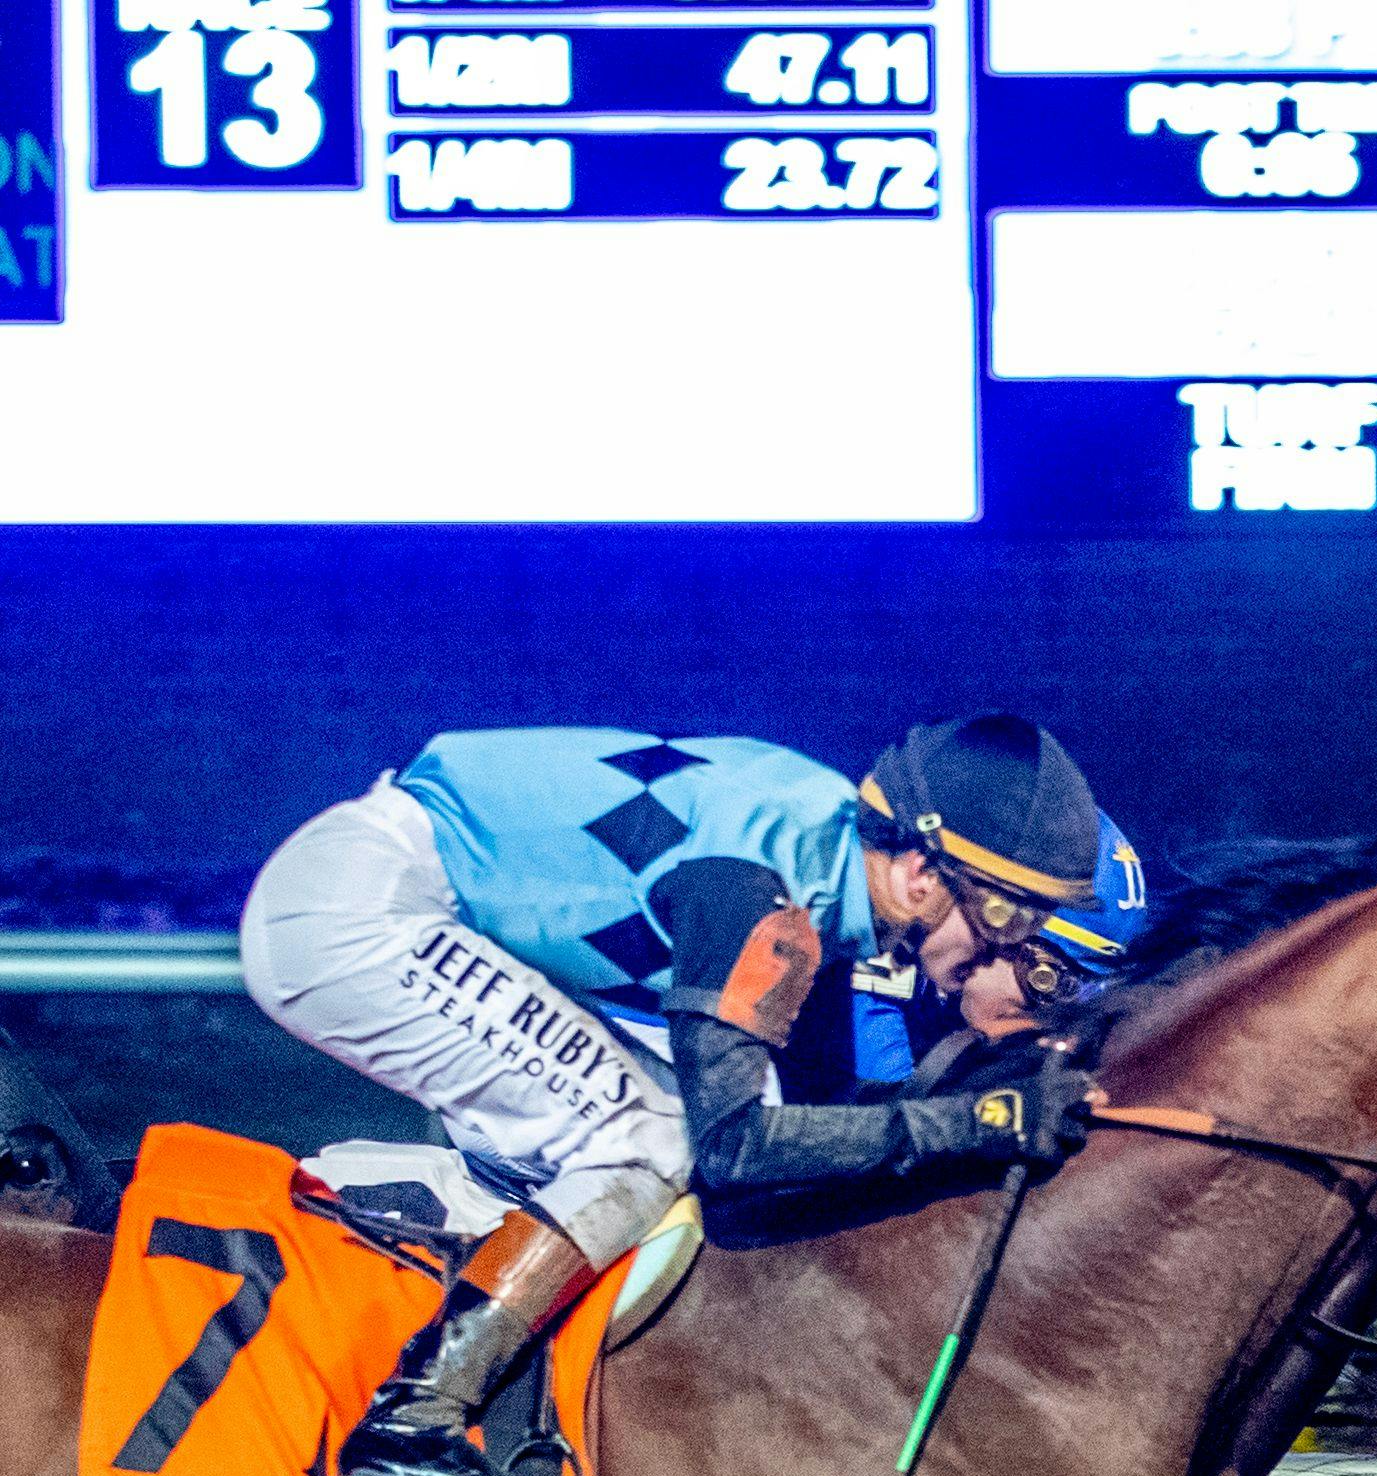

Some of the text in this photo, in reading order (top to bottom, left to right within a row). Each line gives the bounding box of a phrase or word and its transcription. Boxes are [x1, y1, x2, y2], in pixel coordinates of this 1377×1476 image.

[130, 30, 324, 169] 13
[725, 33, 928, 104] 47.11
[723, 137, 937, 210] 23.72
[399, 969, 601, 1121] STEAKHOUSE
[412, 931, 636, 1105] JEFF RUBY'S
[112, 1217, 288, 1473] 7
